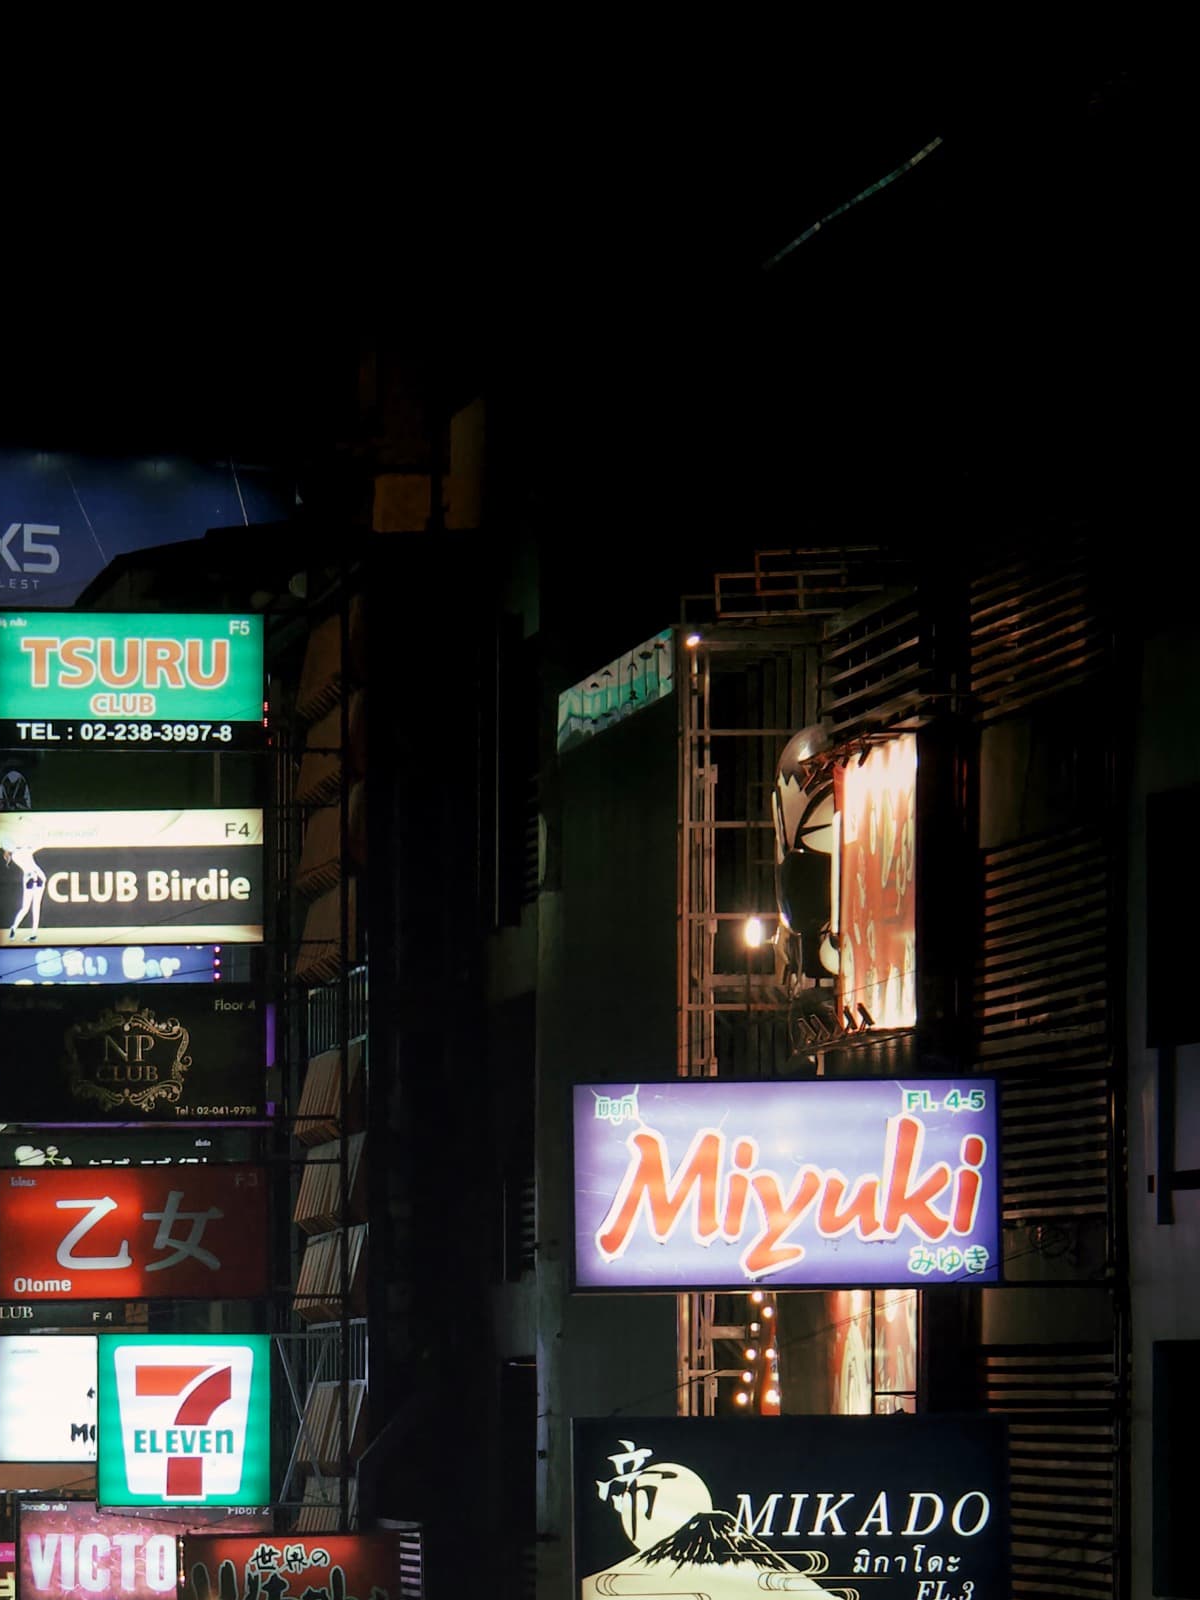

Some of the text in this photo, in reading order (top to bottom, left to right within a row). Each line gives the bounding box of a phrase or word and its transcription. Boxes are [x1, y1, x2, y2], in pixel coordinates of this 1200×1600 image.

[229, 620, 250, 635] F5
[21, 636, 229, 690] TSURU
[90, 693, 156, 716] CLUB
[16, 723, 60, 740] TEL
[81, 723, 232, 741] 02-238-3997-8
[225, 823, 250, 837] F4
[48, 868, 250, 902] CLUB Birdie
[214, 999, 244, 1011] Floor
[103, 1035, 155, 1062] NP
[96, 1065, 159, 1081] CLUB
[945, 1090, 987, 1111] 4-5
[598, 1114, 985, 1276] Miyuki
[56, 1190, 224, 1271] 乙女
[909, 1245, 988, 1275] みゆき
[596, 1440, 677, 1541] 帝
[730, 1491, 991, 1537] MIKADO
[28, 1533, 176, 1592] VICTO
[251, 1544, 329, 1572] 世界の
[853, 1543, 960, 1575] มิกาโดะ
